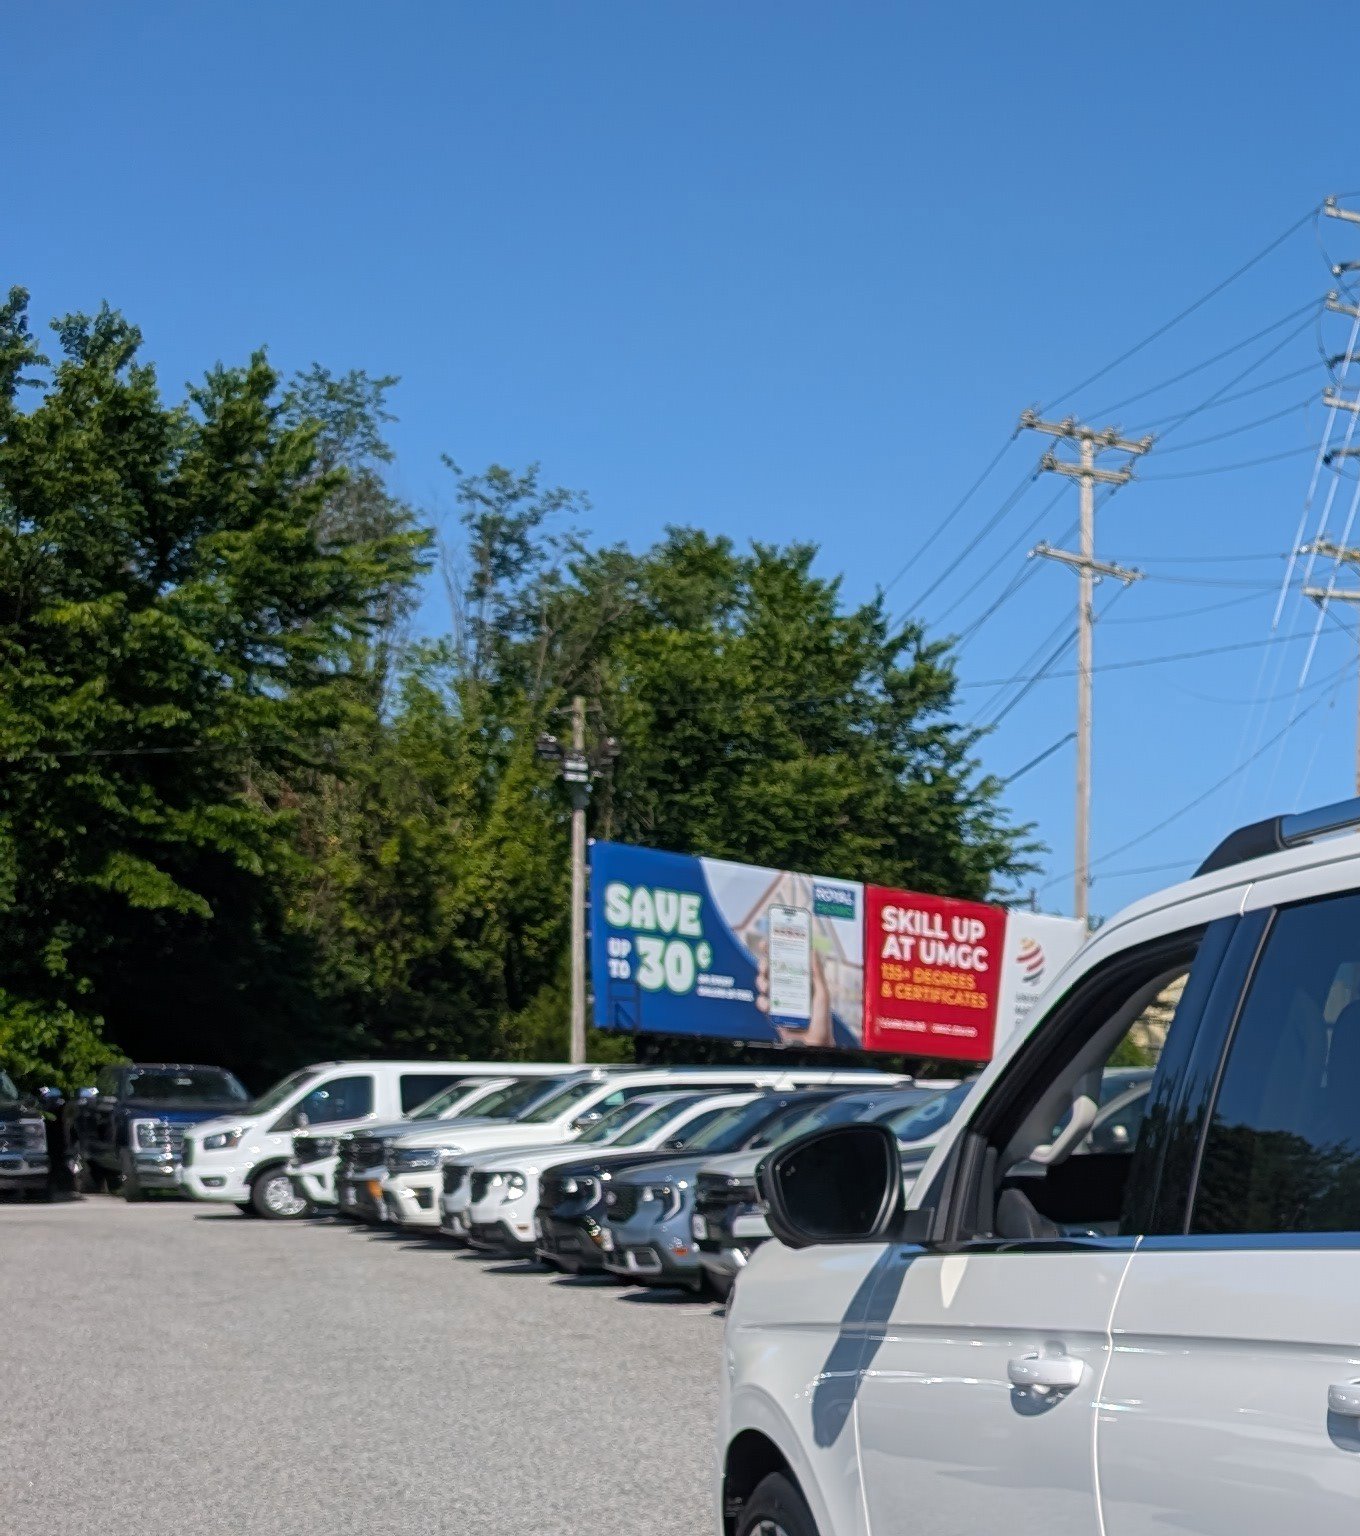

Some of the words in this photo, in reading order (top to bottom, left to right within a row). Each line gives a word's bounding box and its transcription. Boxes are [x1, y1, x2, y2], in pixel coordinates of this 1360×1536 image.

[604, 882, 703, 936] SAVE
[881, 905, 949, 940] SKILL
[952, 915, 986, 944] UP
[607, 937, 632, 958] UP
[881, 933, 916, 962] AT
[919, 938, 989, 972] UMGC
[607, 958, 631, 979] TO
